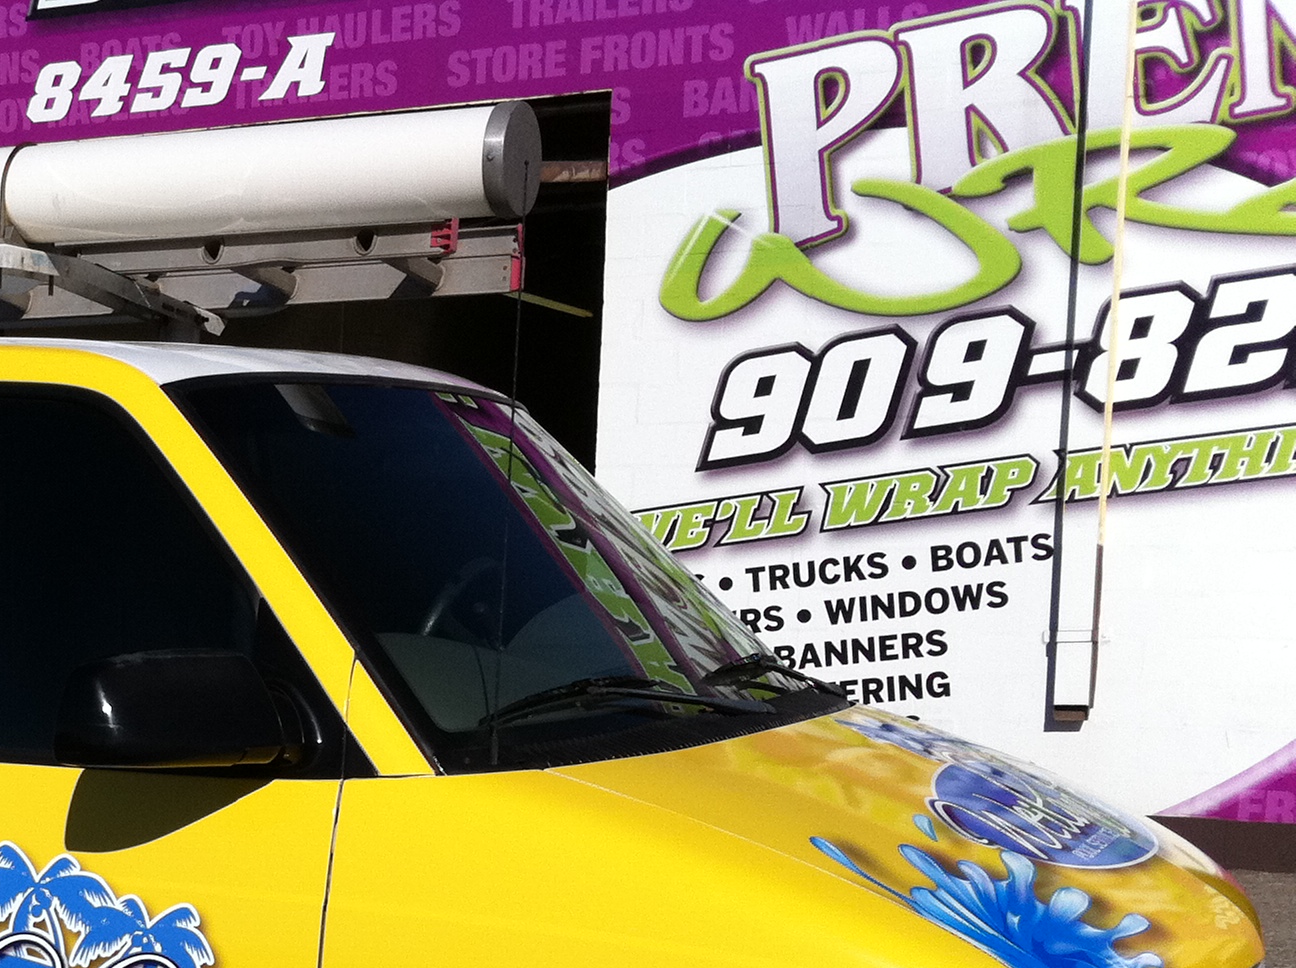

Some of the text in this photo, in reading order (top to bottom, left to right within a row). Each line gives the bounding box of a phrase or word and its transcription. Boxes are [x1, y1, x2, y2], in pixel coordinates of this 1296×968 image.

[222, 20, 286, 59] TOY
[447, 22, 735, 88] STORE FRONTS
[26, 32, 336, 124] 8459-A
[819, 453, 1040, 533] WRAP
[745, 532, 1055, 593] TRUCKS BOATS
[824, 580, 1009, 625] WINDOWS
[773, 629, 949, 671] BANNERS
